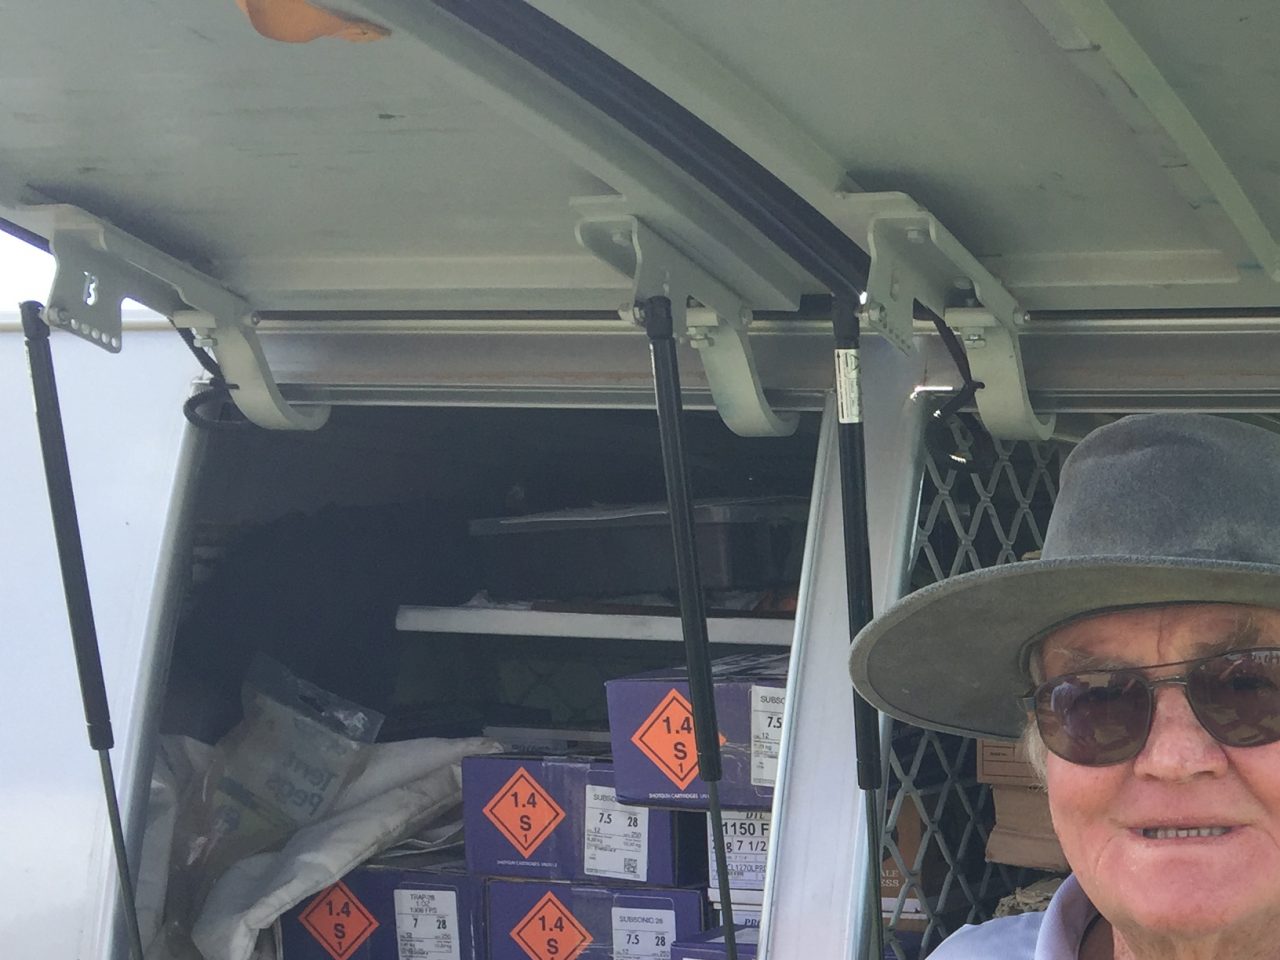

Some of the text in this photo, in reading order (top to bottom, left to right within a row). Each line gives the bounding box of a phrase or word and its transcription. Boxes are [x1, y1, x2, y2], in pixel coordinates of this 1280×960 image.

[662, 716, 693, 734] 1.4
[767, 716, 782, 729] 7.5
[673, 742, 688, 760] S
[678, 763, 683, 773] 1
[511, 791, 537, 808] 1.4
[519, 814, 532, 832] S
[599, 812, 639, 827] 7.5 28
[722, 821, 756, 836] 1150
[523, 834, 529, 844] 1
[749, 840, 767, 852] 1/2
[326, 901, 351, 918] 1.4
[333, 923, 346, 940] S
[413, 918, 447, 930] 7 28
[538, 915, 565, 933] 1.4
[338, 942, 343, 951] 1
[546, 938, 559, 955] S
[626, 933, 666, 947] 7.5 28
